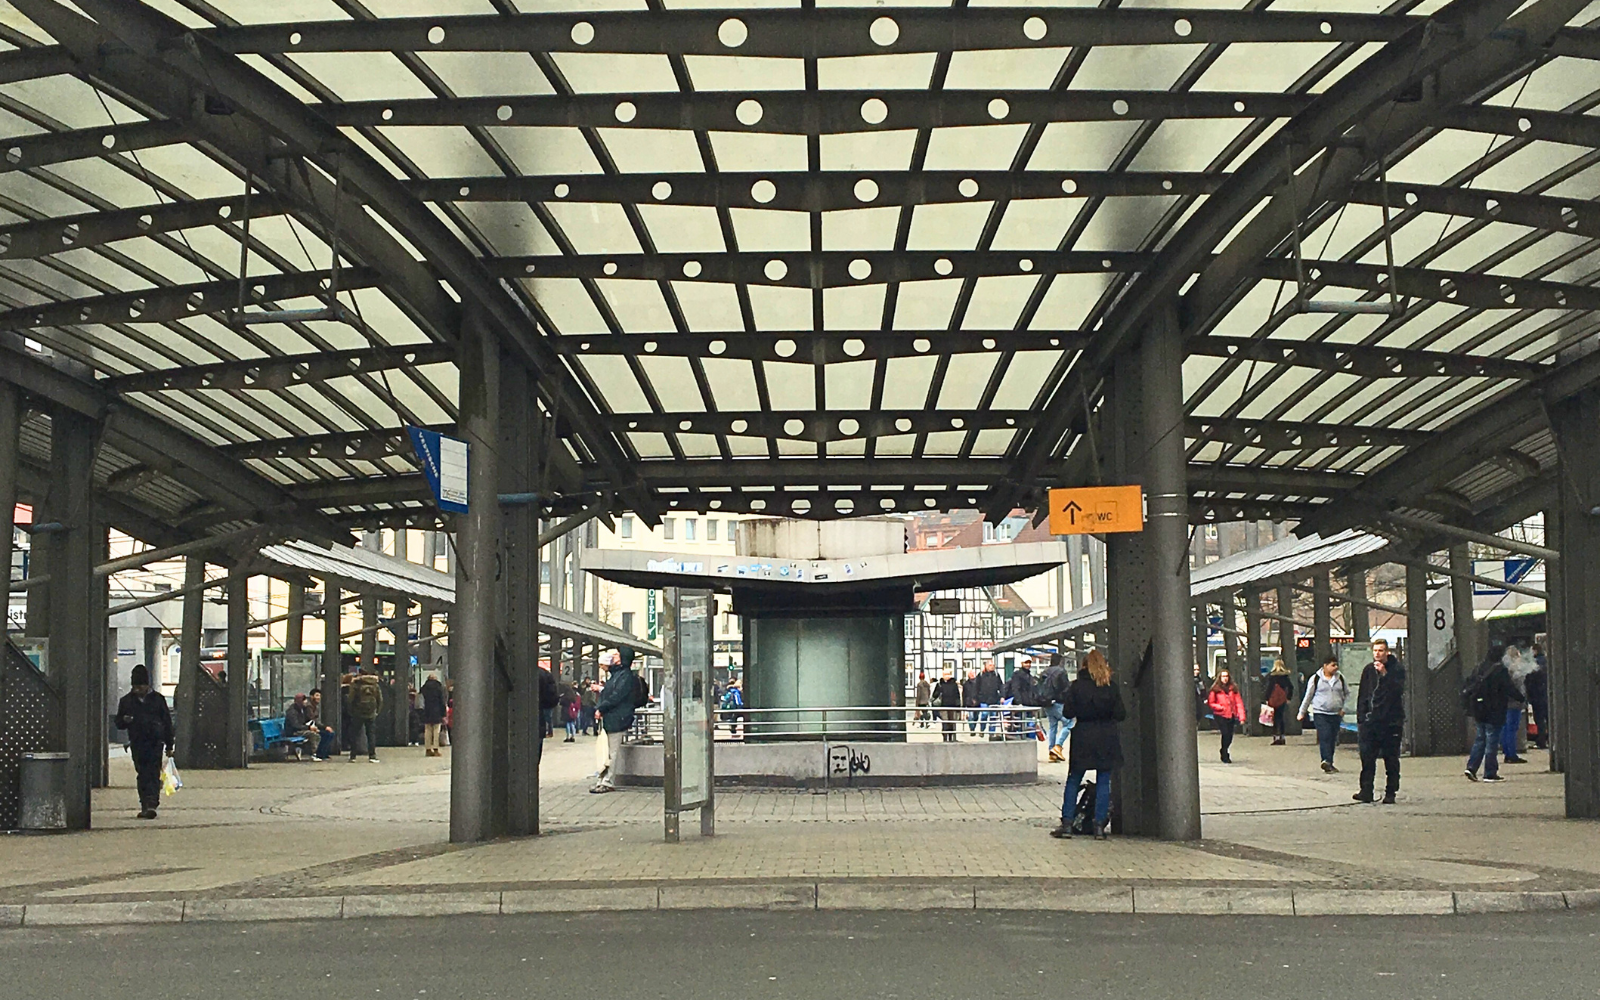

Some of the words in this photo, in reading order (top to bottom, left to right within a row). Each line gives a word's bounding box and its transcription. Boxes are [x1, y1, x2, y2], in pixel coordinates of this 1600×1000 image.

[418, 431, 439, 479] VESTISCHE
[1096, 512, 1113, 521] WC
[648, 588, 656, 623] OTEL
[1433, 608, 1446, 630] 8
[564, 665, 571, 676] 2
